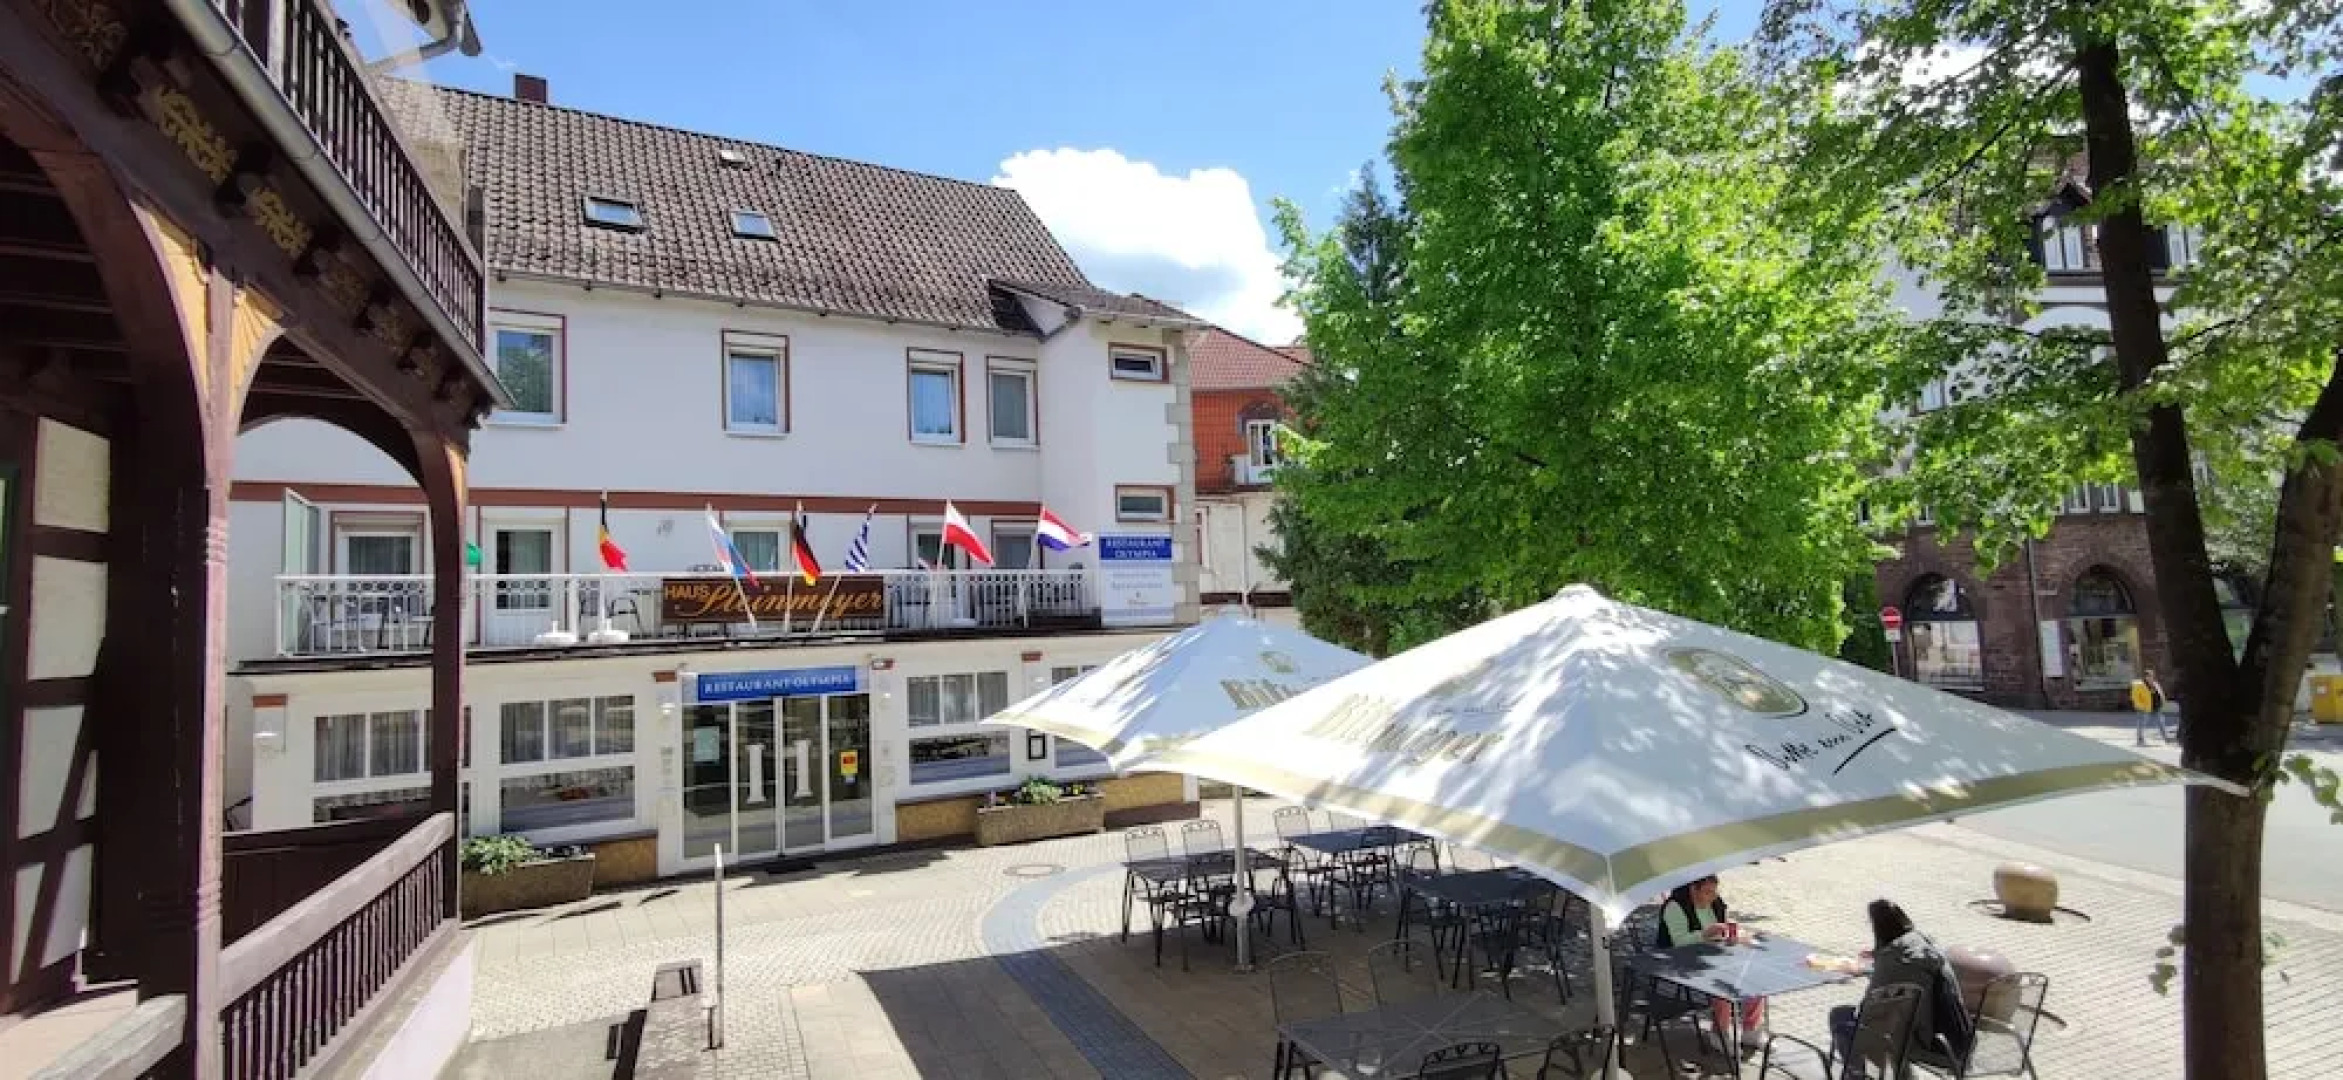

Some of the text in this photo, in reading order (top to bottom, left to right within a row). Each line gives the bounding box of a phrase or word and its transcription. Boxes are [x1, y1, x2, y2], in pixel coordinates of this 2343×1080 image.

[664, 584, 710, 600] HAUS
[704, 673, 850, 694] RESTAURANT OLYMPIA
